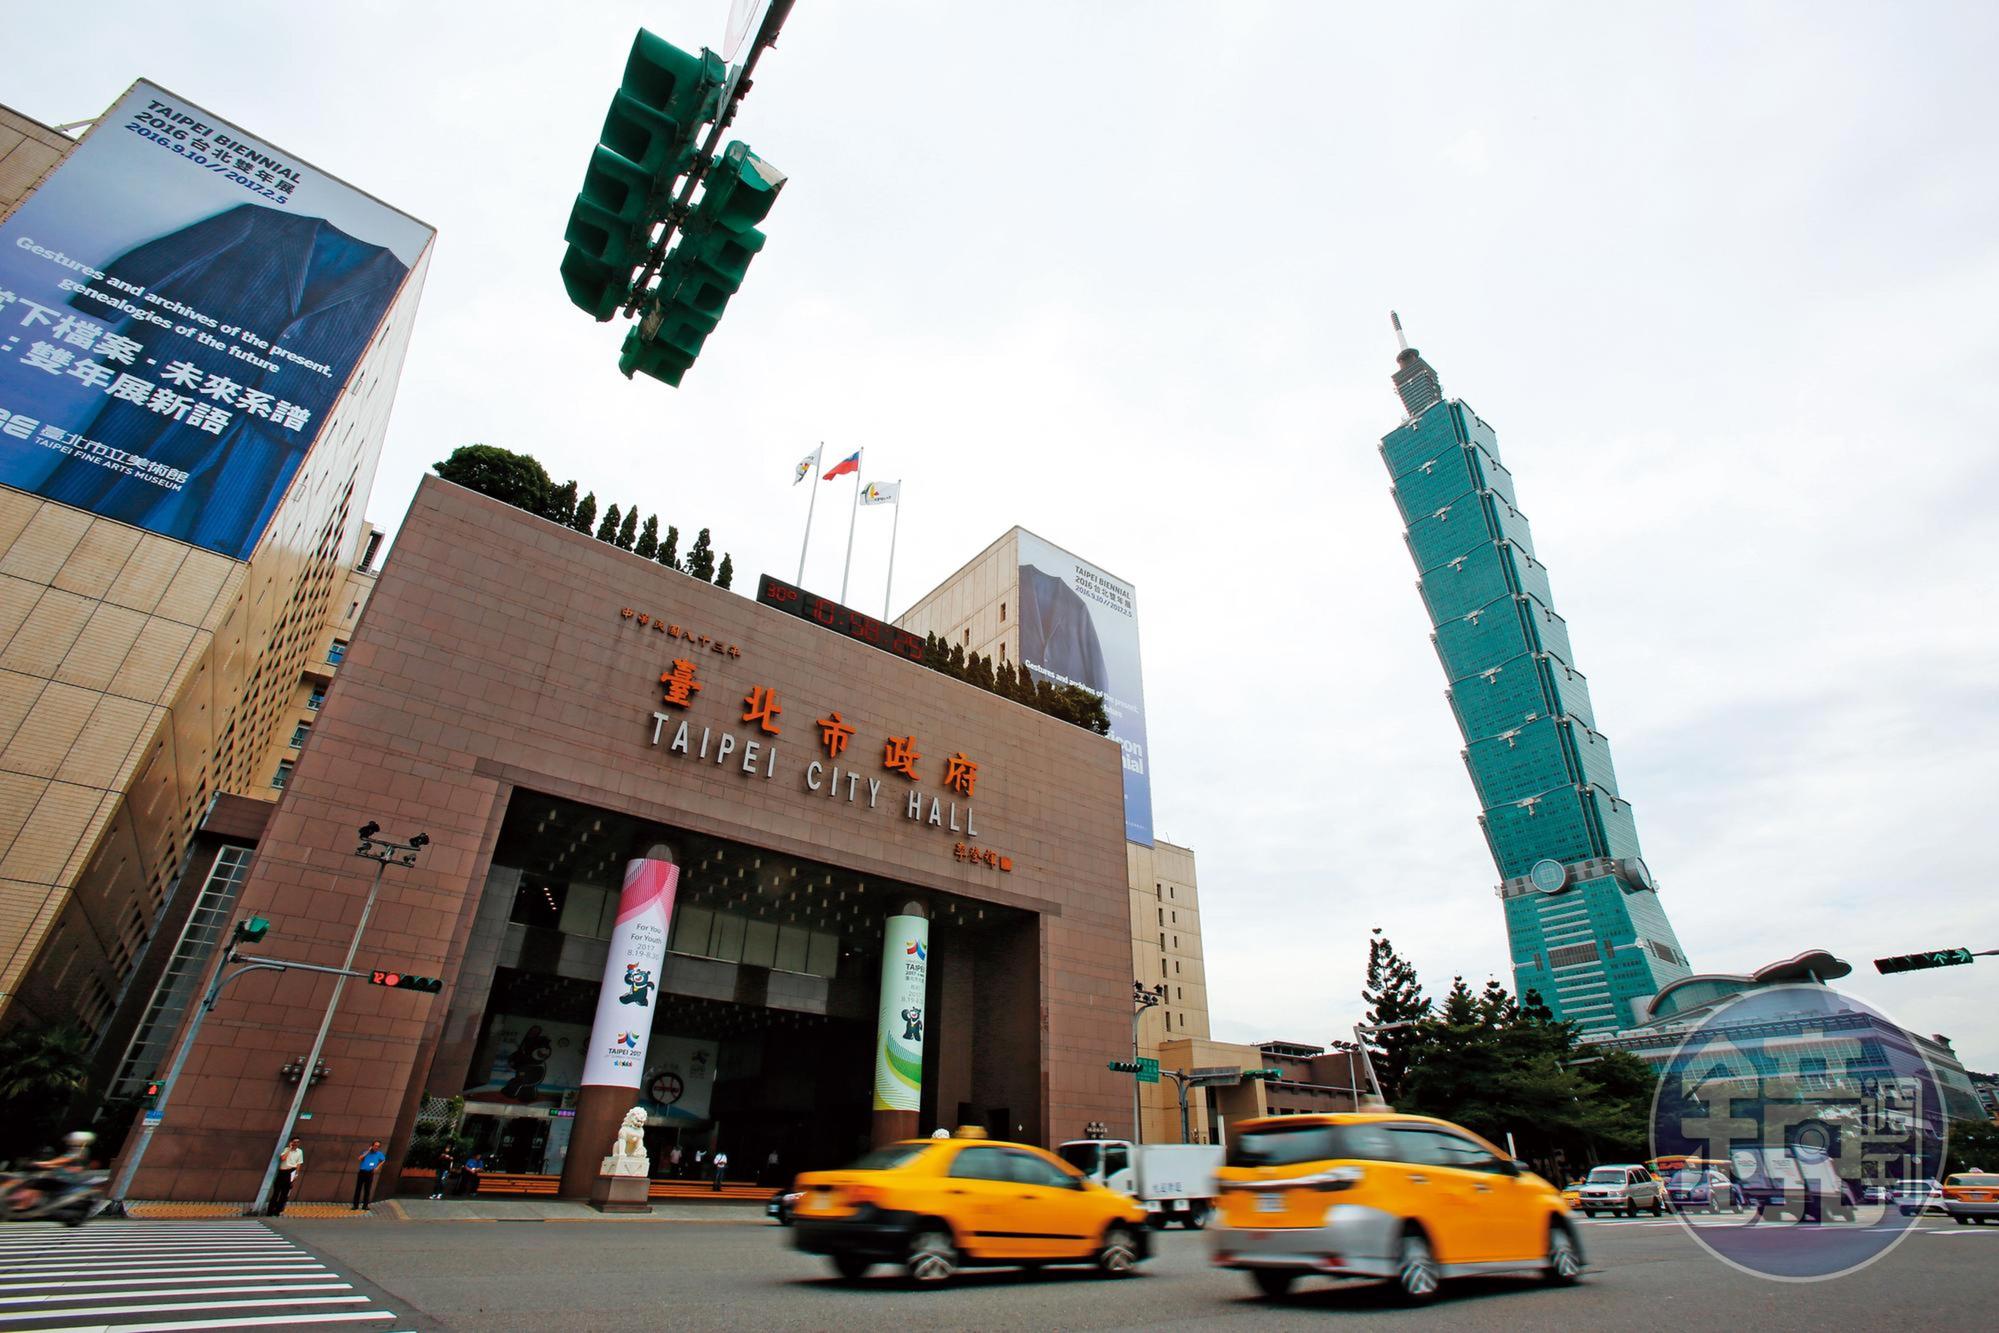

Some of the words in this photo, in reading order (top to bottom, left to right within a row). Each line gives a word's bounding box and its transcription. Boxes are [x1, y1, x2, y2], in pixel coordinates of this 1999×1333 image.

[134, 111, 190, 141] 2016
[190, 138, 296, 195] 台北雙年展
[148, 100, 214, 137] TAIPEI
[213, 134, 301, 184] BIENNIAL
[16, 236, 106, 281] Gestures
[106, 276, 146, 297] and
[144, 292, 219, 328] archives
[219, 324, 242, 337] of
[240, 330, 269, 350] the
[269, 345, 333, 379] present,
[57, 278, 174, 329] genealogies
[175, 324, 198, 338] of
[197, 332, 227, 351] the
[228, 345, 280, 373] future
[34, 436, 73, 455] TAIPEI
[73, 450, 101, 465] FINE
[102, 459, 134, 476] ARTS
[134, 470, 183, 492] MUSEUM
[39, 423, 190, 484] 臺北市立美術館
[1074, 565, 1098, 583] TAIPEI
[1098, 577, 1132, 600] BIENNIAL
[1075, 575, 1093, 590] 2016
[1024, 659, 1056, 679] Gestures
[1055, 673, 1069, 685] and
[659, 657, 980, 797] 臺北市政府
[651, 711, 777, 780] TAIPEI
[806, 760, 882, 809] CITY
[906, 789, 979, 838] HALL
[636, 923, 649, 931] For
[649, 926, 662, 934] You
[608, 1048, 629, 1056] TAIPEI
